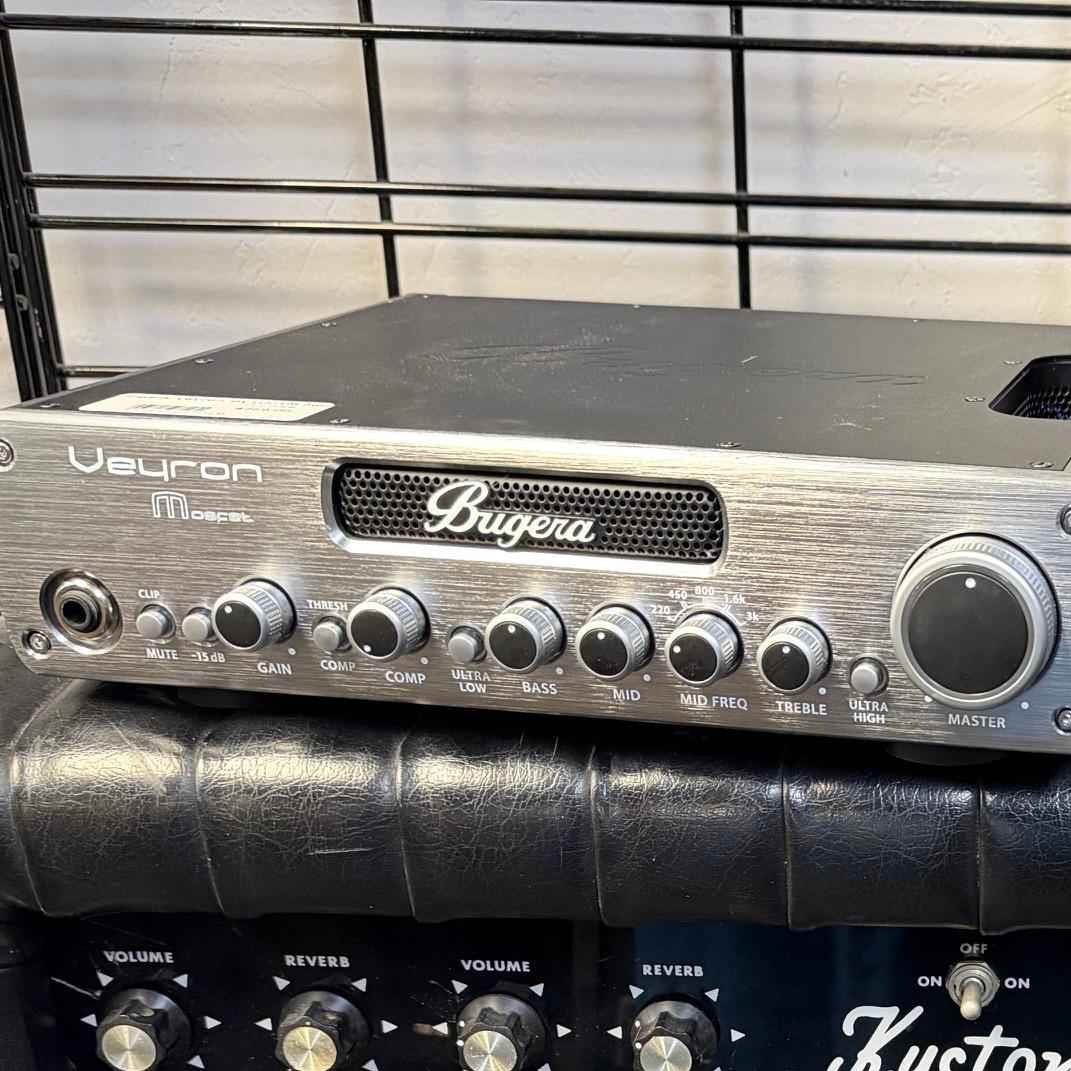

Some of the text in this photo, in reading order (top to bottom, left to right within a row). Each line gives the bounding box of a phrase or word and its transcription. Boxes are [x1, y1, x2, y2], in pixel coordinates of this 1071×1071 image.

[68, 446, 262, 482] Veyron
[151, 491, 254, 523] Mosfet
[424, 480, 596, 548] Bugera
[138, 589, 160, 599] CLIP
[668, 590, 688, 600] 450
[694, 586, 715, 596] 800
[307, 600, 348, 611] THRESH
[724, 594, 746, 604] 1.6k
[651, 605, 671, 615] 220
[746, 612, 760, 621] 3k
[147, 648, 179, 660] MUTE
[257, 662, 292, 675] GAIN
[320, 659, 356, 672] COMP
[385, 670, 426, 685] COMP
[452, 669, 491, 682] ULTRA
[459, 682, 487, 694] LOW
[522, 681, 557, 695] BASS
[613, 688, 641, 701] MID
[680, 693, 748, 712] MID FREQ
[775, 701, 827, 716] TREBLE
[849, 700, 889, 712] ULTRA
[853, 712, 885, 724] HIGH
[948, 714, 1006, 729] MASTER
[960, 942, 988, 955] OFF
[104, 950, 174, 964] VOLUME
[284, 954, 350, 968] REVERB
[461, 959, 531, 973] VOLUME
[642, 964, 704, 977] REVERB
[917, 975, 943, 988] ON
[1004, 977, 1030, 989] ON
